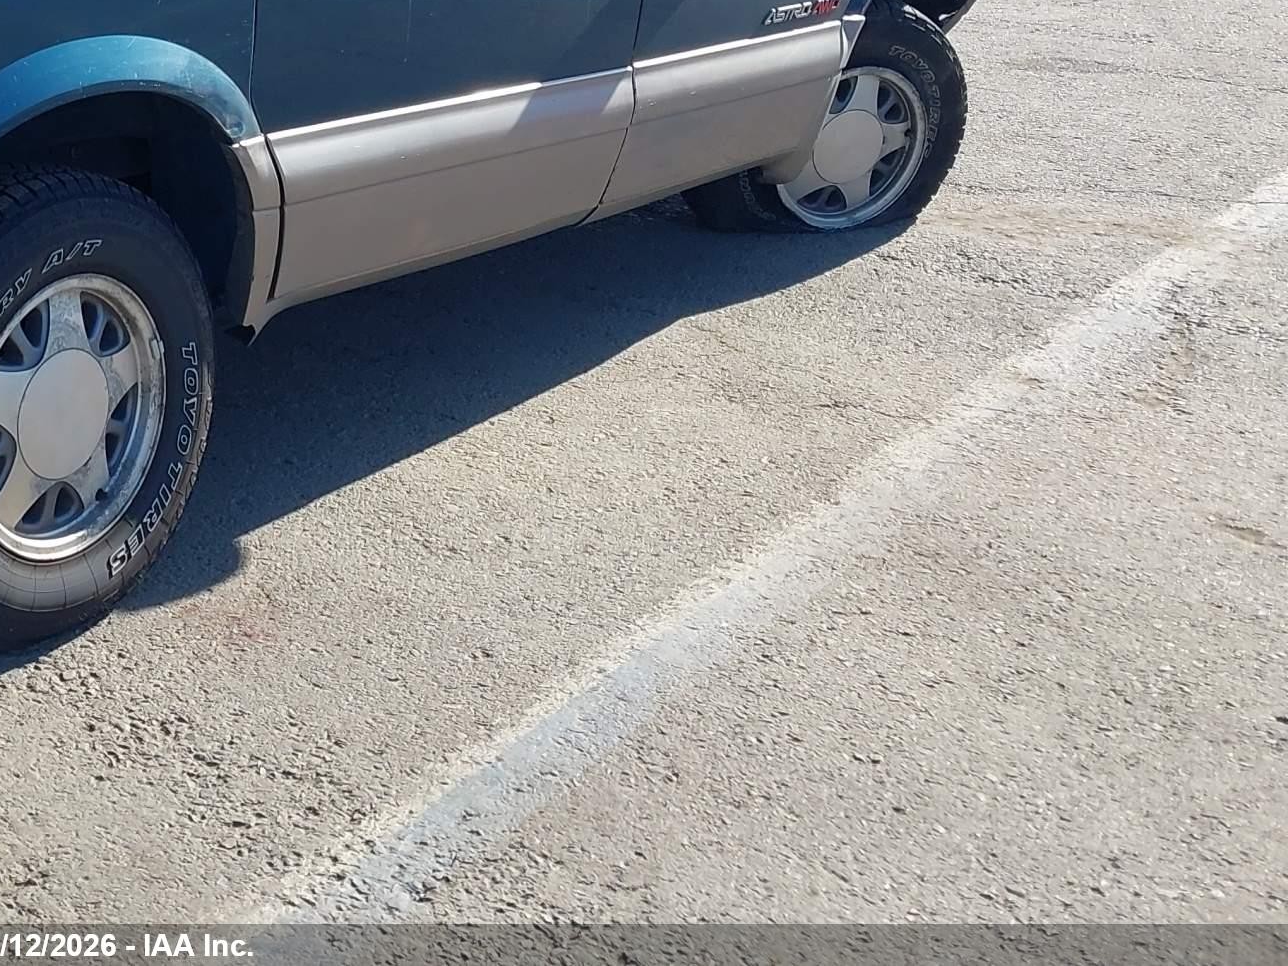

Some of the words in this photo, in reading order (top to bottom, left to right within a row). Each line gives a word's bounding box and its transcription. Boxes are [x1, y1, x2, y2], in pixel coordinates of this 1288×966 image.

[763, 1, 813, 26] ASTRO
[41, 239, 102, 274] A/T
[177, 341, 199, 456] TOYO
[108, 462, 183, 577] TIRES
